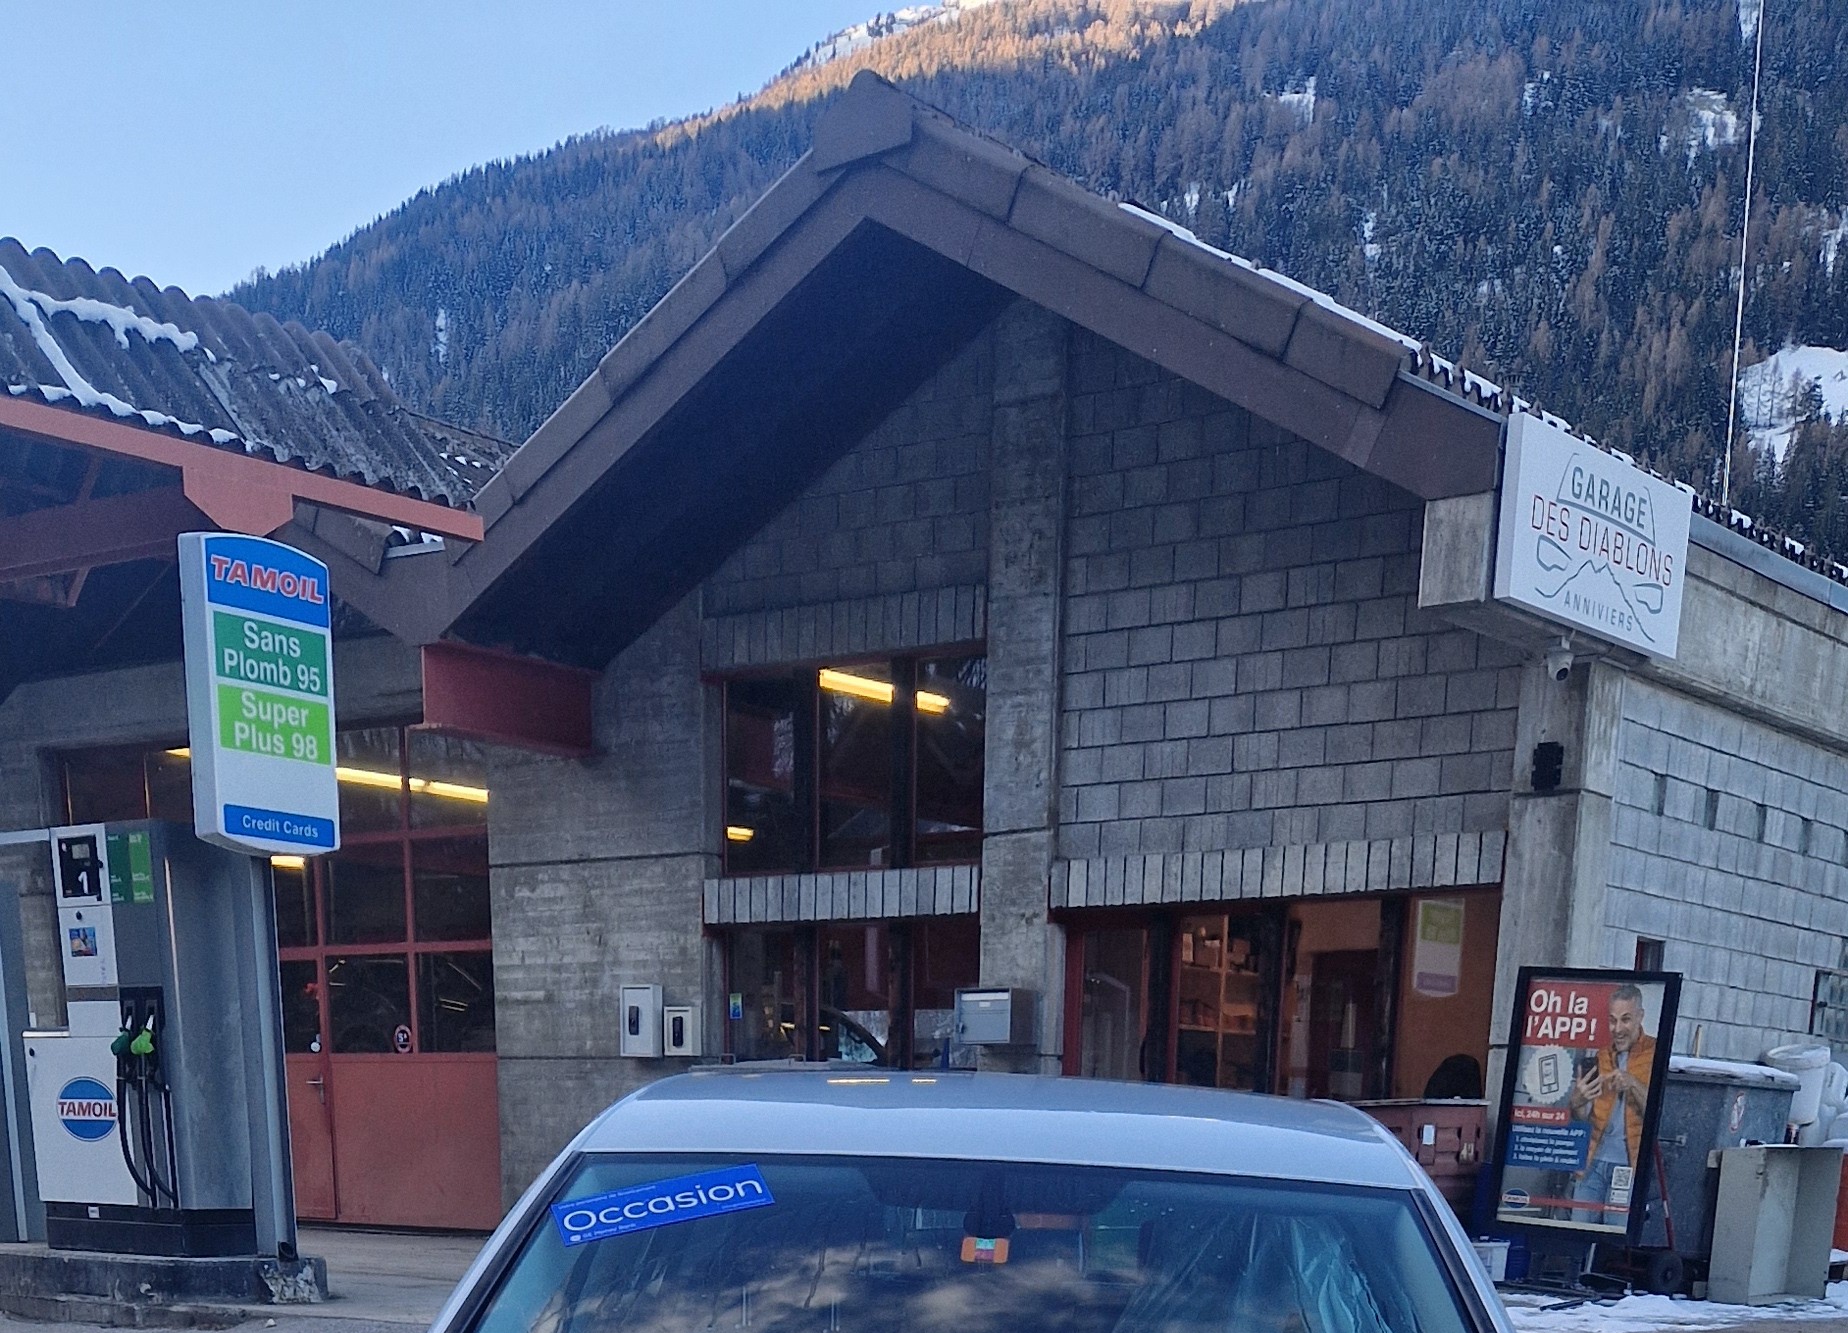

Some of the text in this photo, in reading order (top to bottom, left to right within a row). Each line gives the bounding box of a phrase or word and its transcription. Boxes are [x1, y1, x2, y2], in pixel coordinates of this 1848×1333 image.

[1571, 466, 1648, 530] GARAGE
[1531, 495, 1673, 586] DES DIABLONS
[211, 554, 324, 604] TAMOIL
[1564, 590, 1633, 631] ANNIVIERS
[243, 620, 301, 658] Sans
[223, 648, 320, 692] Plomb 95
[241, 691, 309, 729] Super
[234, 721, 318, 760] Plus 98
[242, 815, 318, 838] Credit Cards
[1530, 989, 1588, 1015] Oh la
[58, 1102, 116, 1117] TAMOIL
[563, 1179, 763, 1231] Occasion
